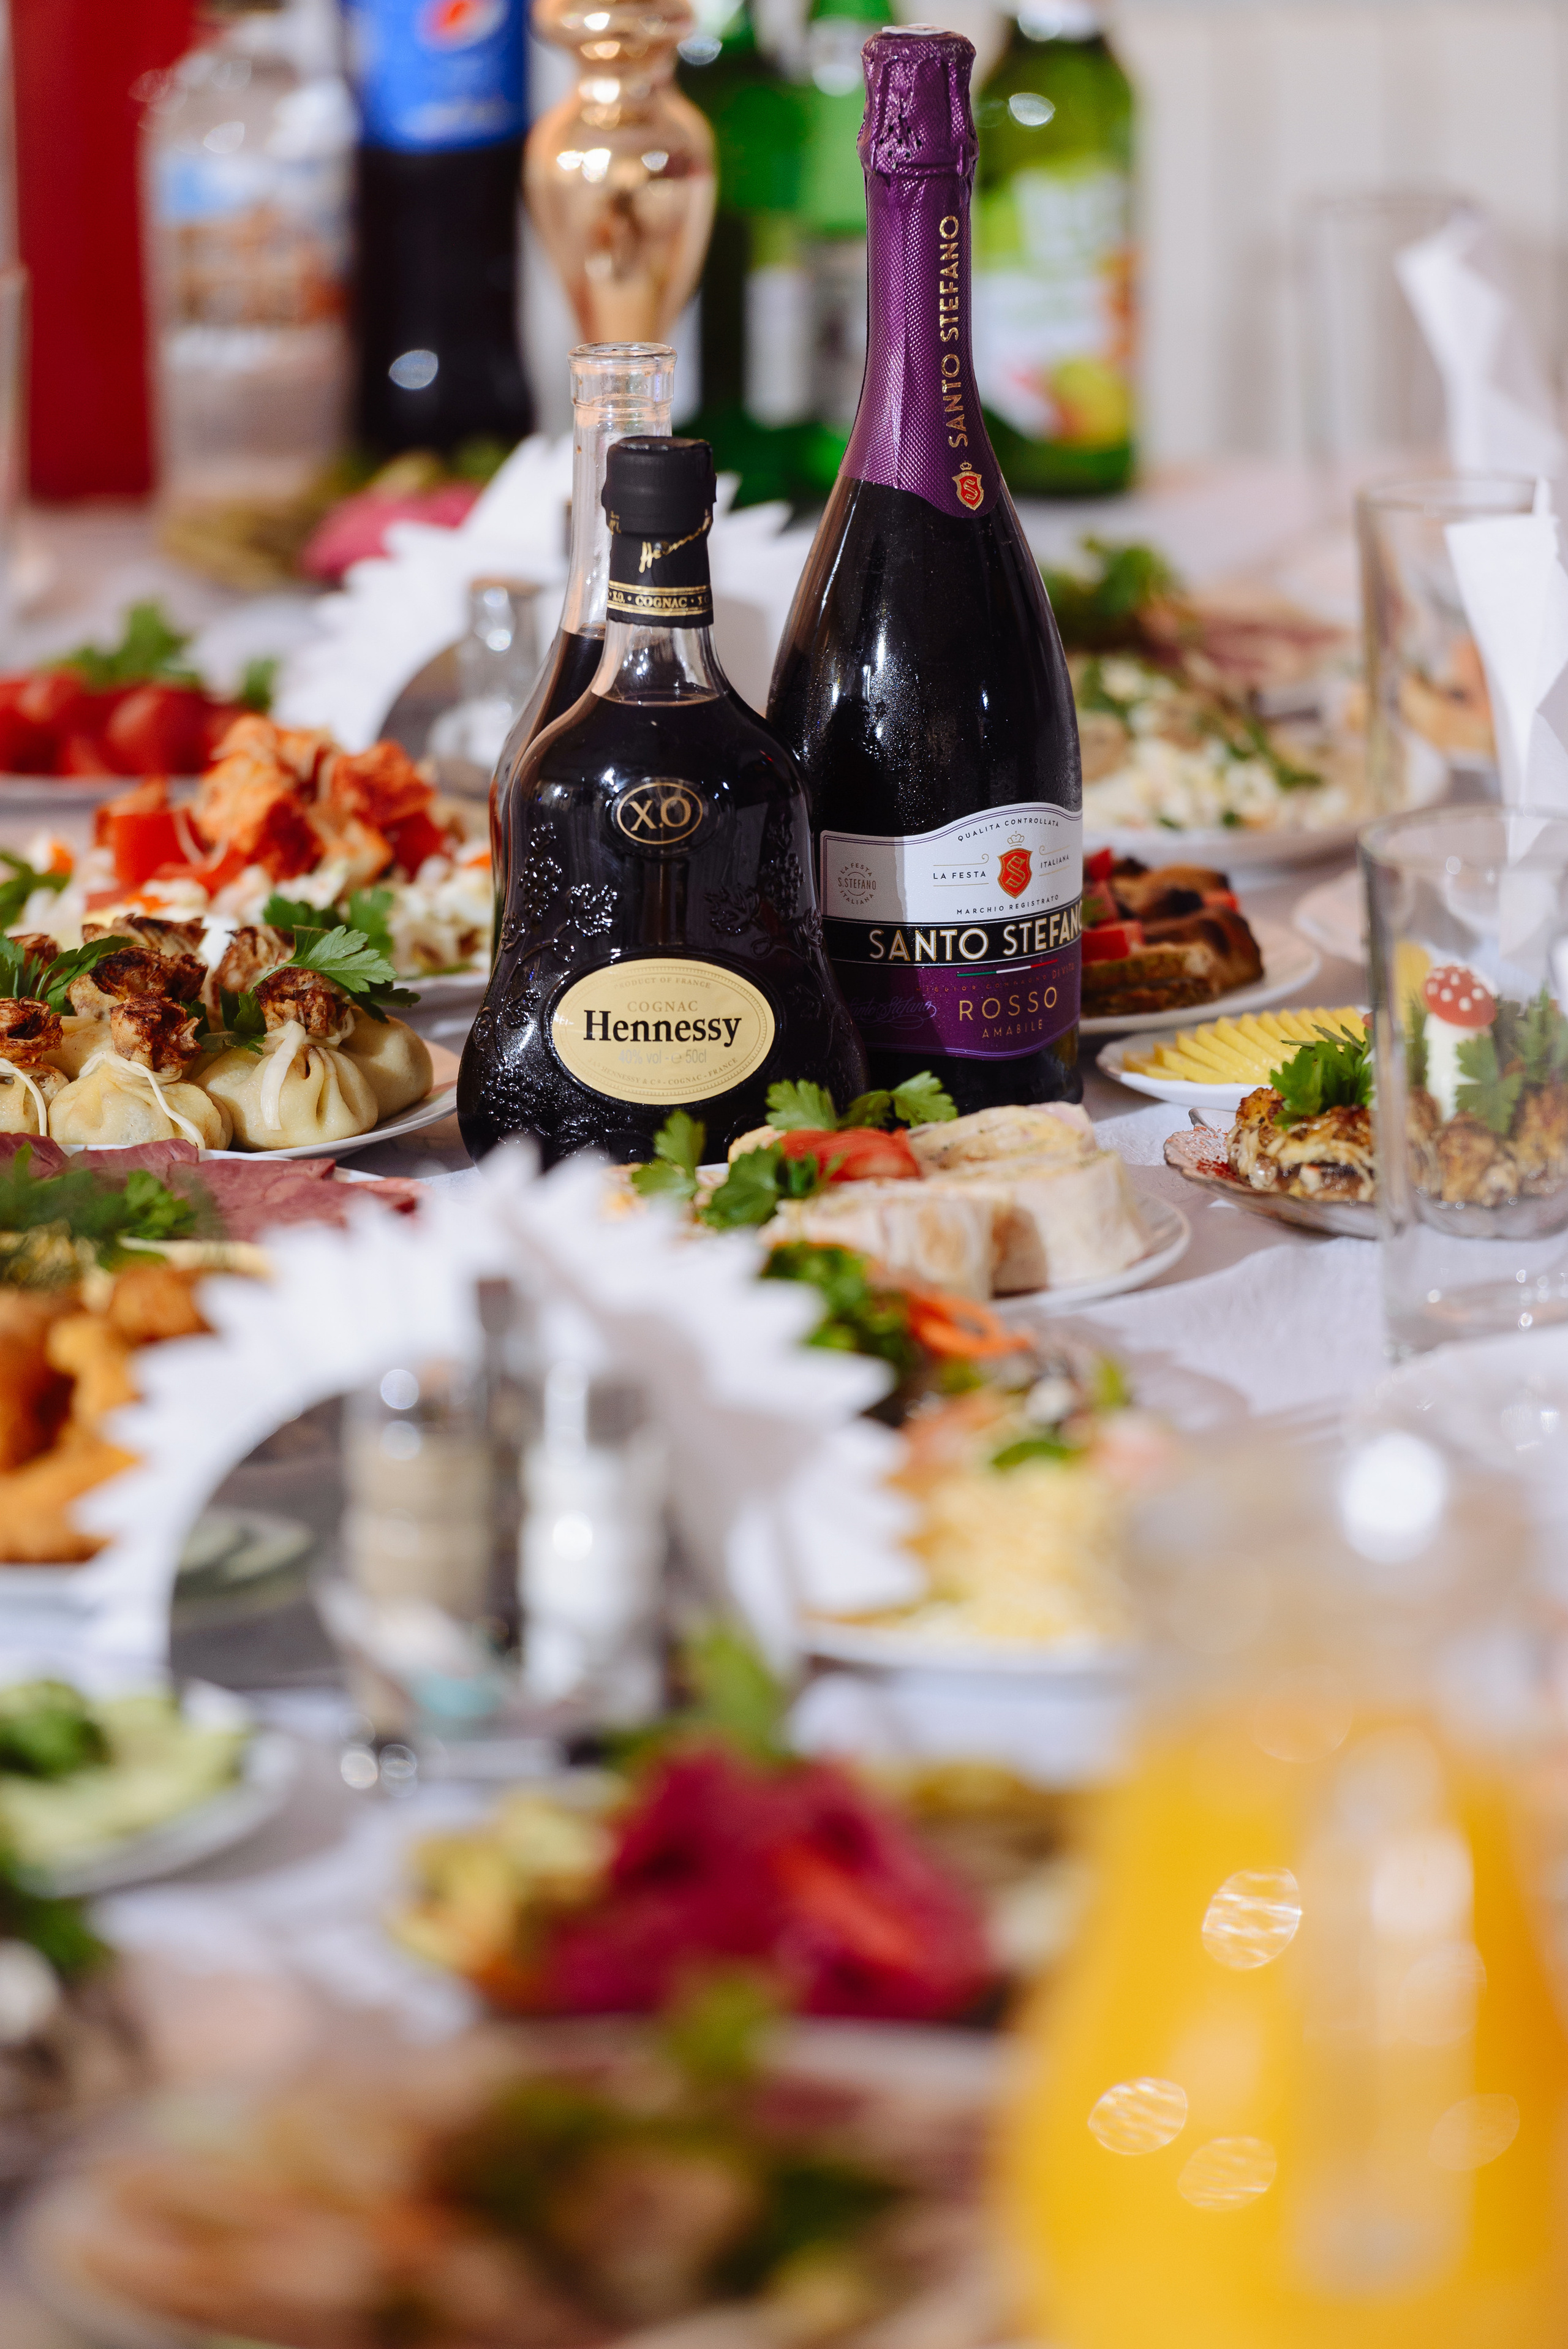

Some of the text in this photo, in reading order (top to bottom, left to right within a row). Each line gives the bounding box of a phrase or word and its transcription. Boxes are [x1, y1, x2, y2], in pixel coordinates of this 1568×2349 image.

[939, 216, 968, 448] SANTO STEFANO
[635, 595, 688, 608] COGNAC
[628, 796, 692, 831] X.O
[957, 817, 1059, 842] QUALITA CONTROLLATA
[840, 863, 872, 877] LA FESTA
[1040, 854, 1069, 869] ITALIANA
[837, 877, 876, 890] S.STEFANO
[952, 871, 987, 879] FESTA
[840, 890, 875, 905] ITALIANA
[956, 894, 1059, 915] MARCHIO REGISTRATO
[869, 928, 989, 961] SANTO
[614, 977, 657, 989] PRODUCT
[676, 977, 711, 989] FRANCE
[627, 1000, 698, 1013] COGNAC
[959, 986, 1058, 1021] ROSSO
[582, 1009, 742, 1048] Hennessy
[982, 1019, 1042, 1038] AMABILE
[617, 1049, 643, 1064] 40%
[646, 1049, 662, 1064] vol
[685, 1049, 707, 1064] 50cl
[668, 1074, 702, 1085] COGNAC
[708, 1057, 738, 1078] FRANCE
